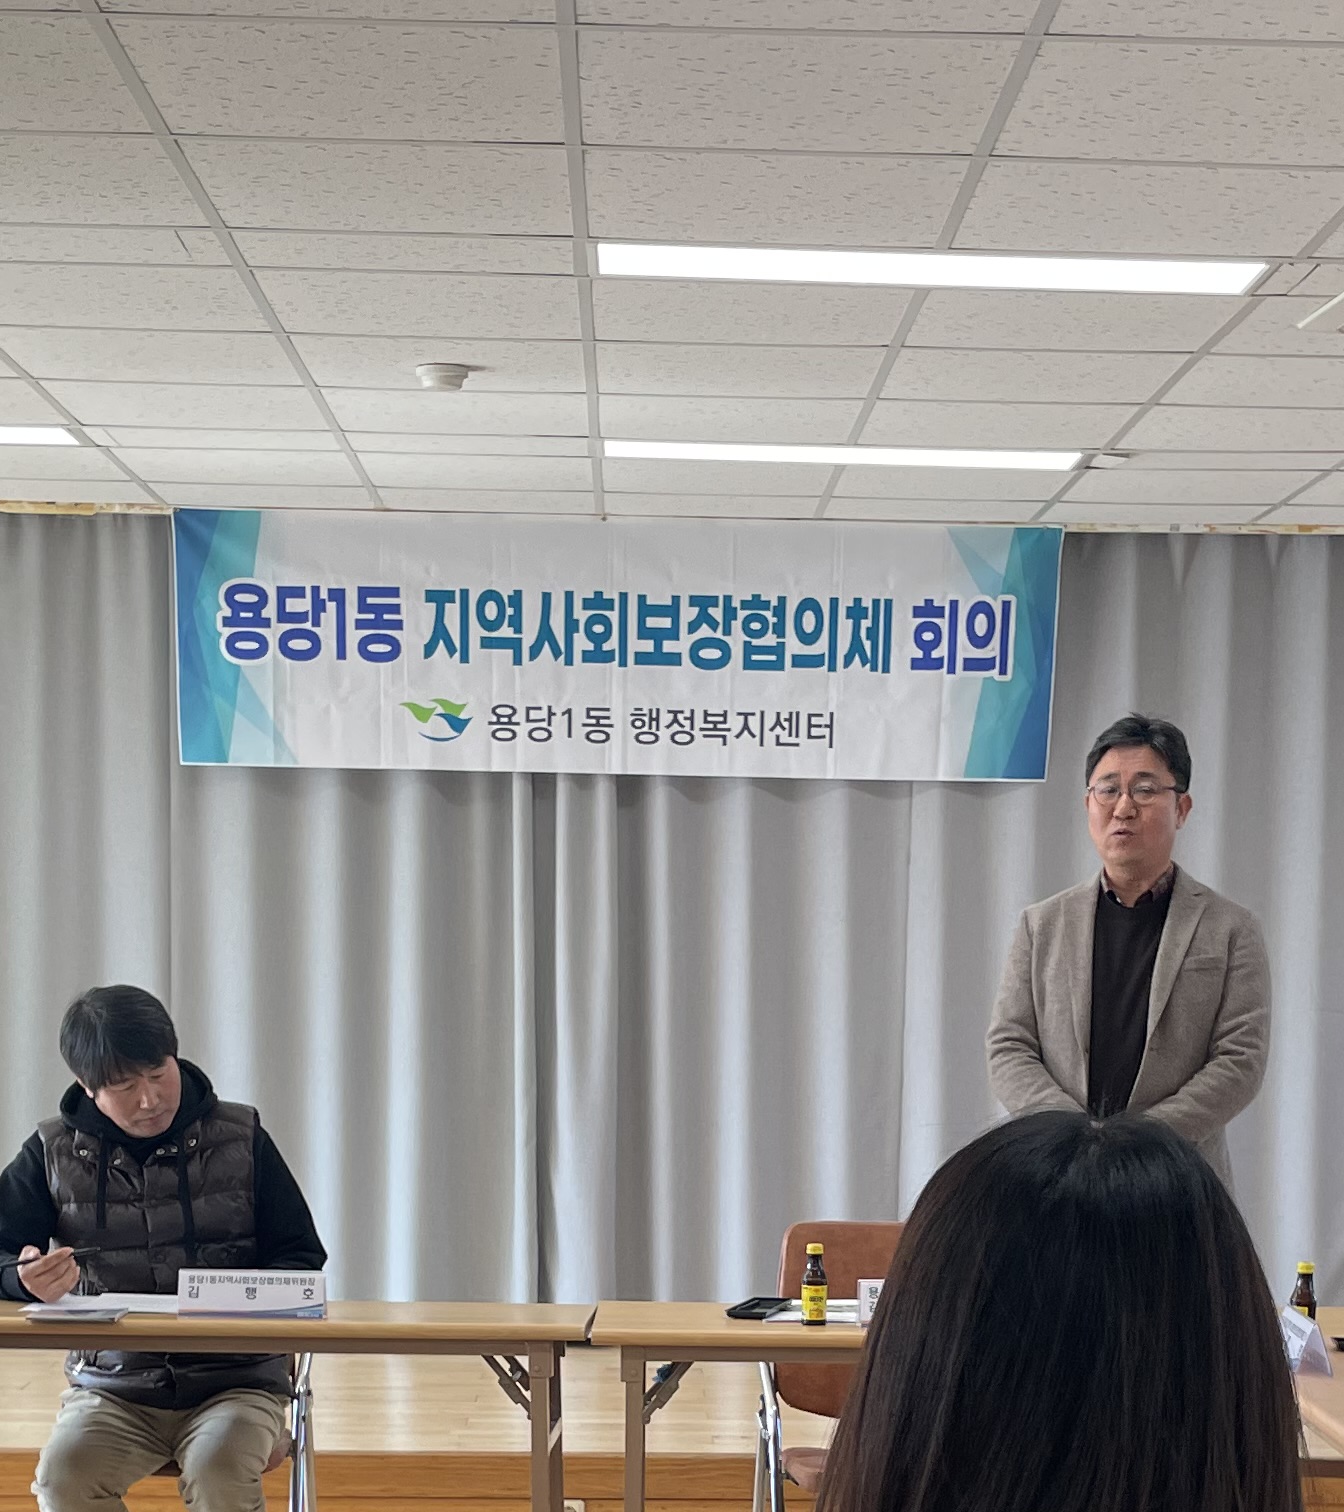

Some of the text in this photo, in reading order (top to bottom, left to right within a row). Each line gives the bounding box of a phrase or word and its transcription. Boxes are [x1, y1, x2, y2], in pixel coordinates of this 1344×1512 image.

[220, 582, 1012, 677] 용당1동 지역사회보장협의체 회의
[487, 703, 836, 749] 용당1동 행정복지센터
